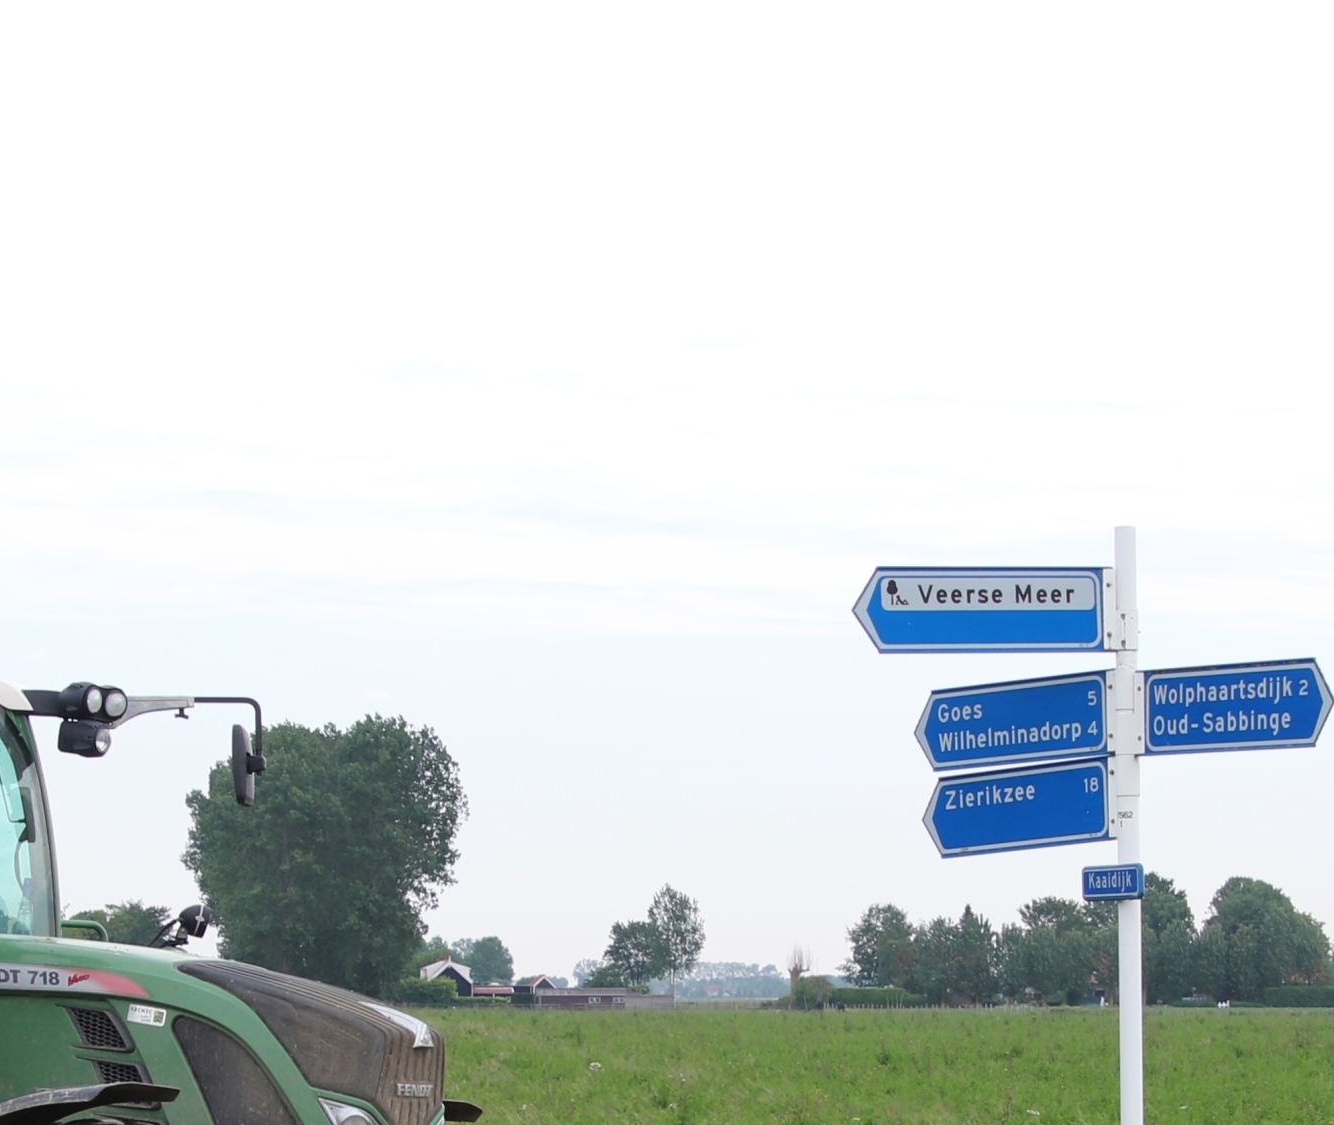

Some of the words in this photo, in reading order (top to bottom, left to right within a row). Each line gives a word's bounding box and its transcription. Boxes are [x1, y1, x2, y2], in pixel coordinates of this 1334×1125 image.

[917, 584, 1003, 604] Veerse
[1015, 584, 1075, 604] Meer
[1154, 676, 1293, 707] Wolphaartsdijk
[1298, 679, 1309, 696] 2
[937, 703, 983, 723] Goes
[1087, 690, 1097, 706] 5
[1153, 710, 1291, 736] Oud-Sabbinge
[938, 721, 1082, 752] Wilhelminadorp
[1087, 721, 1098, 736] 4
[945, 785, 1036, 810] Zierikzee
[1083, 777, 1099, 793] 18
[1088, 871, 1132, 892] Kaaidijk
[27, 970, 60, 986] 718
[397, 1083, 434, 1098] FENDT
